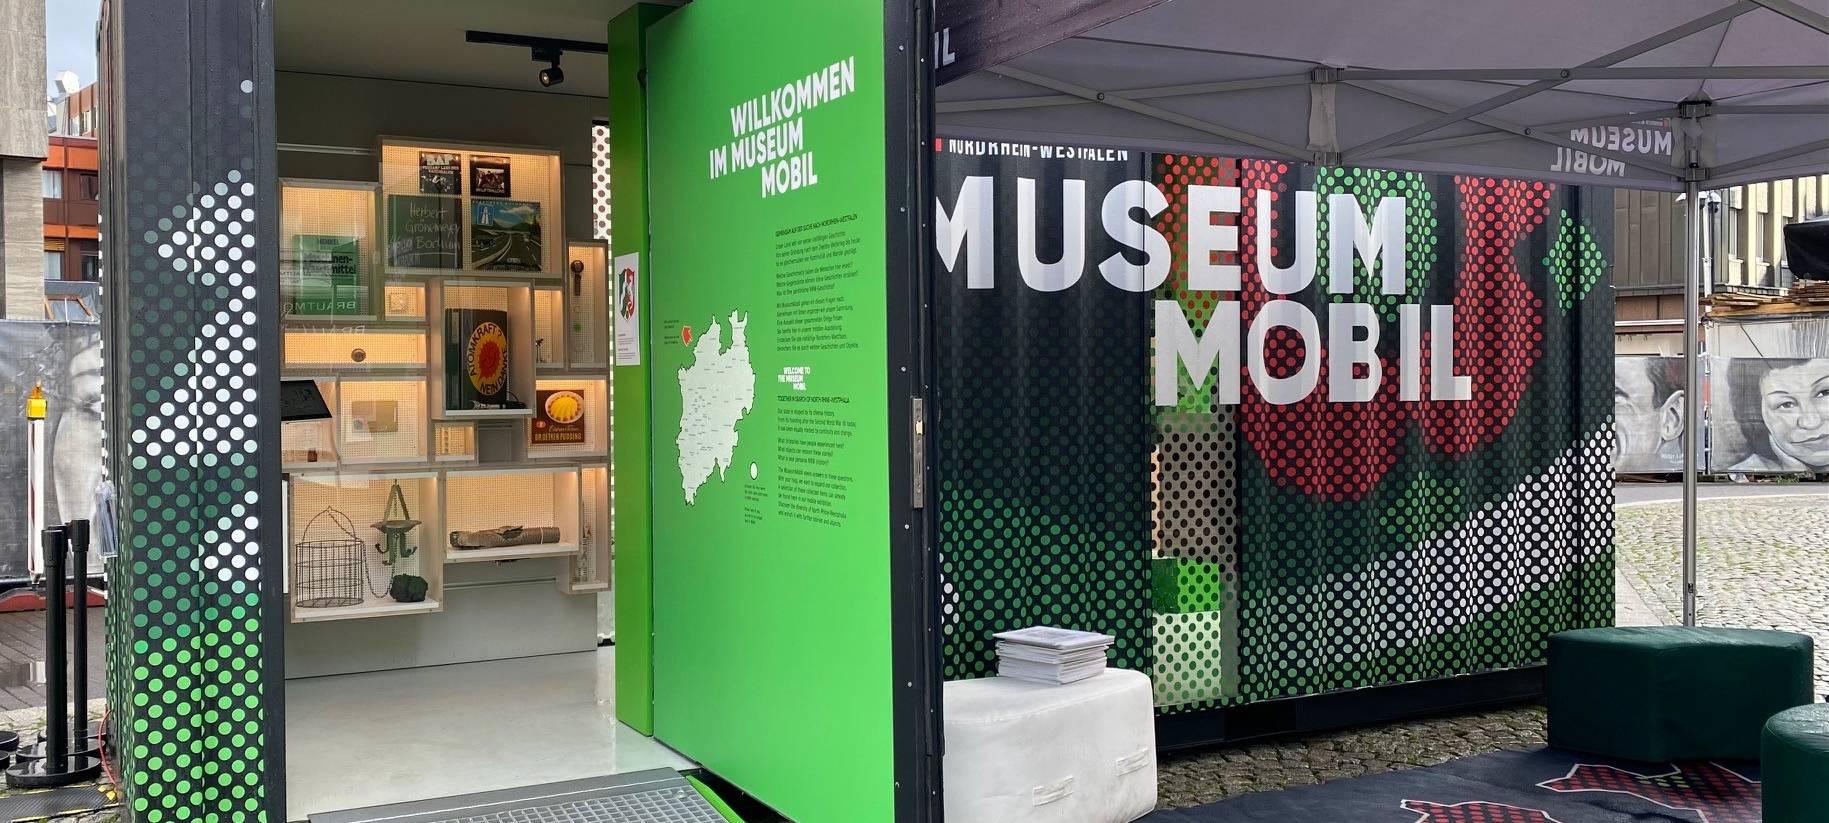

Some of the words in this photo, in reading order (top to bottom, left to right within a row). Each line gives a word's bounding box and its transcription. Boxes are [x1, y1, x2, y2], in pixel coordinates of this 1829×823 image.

[730, 56, 854, 138] WILLKOMMEN
[710, 145, 727, 180] IM
[732, 117, 803, 172] MUSEUM
[762, 151, 818, 198] MOBIL
[410, 202, 448, 220] Herbert
[936, 176, 1406, 295] MUSEUM
[480, 382, 498, 395] NEIN
[498, 349, 508, 386] DANKE
[784, 366, 804, 374] WELCOME
[1154, 300, 1472, 405] MOBIL
